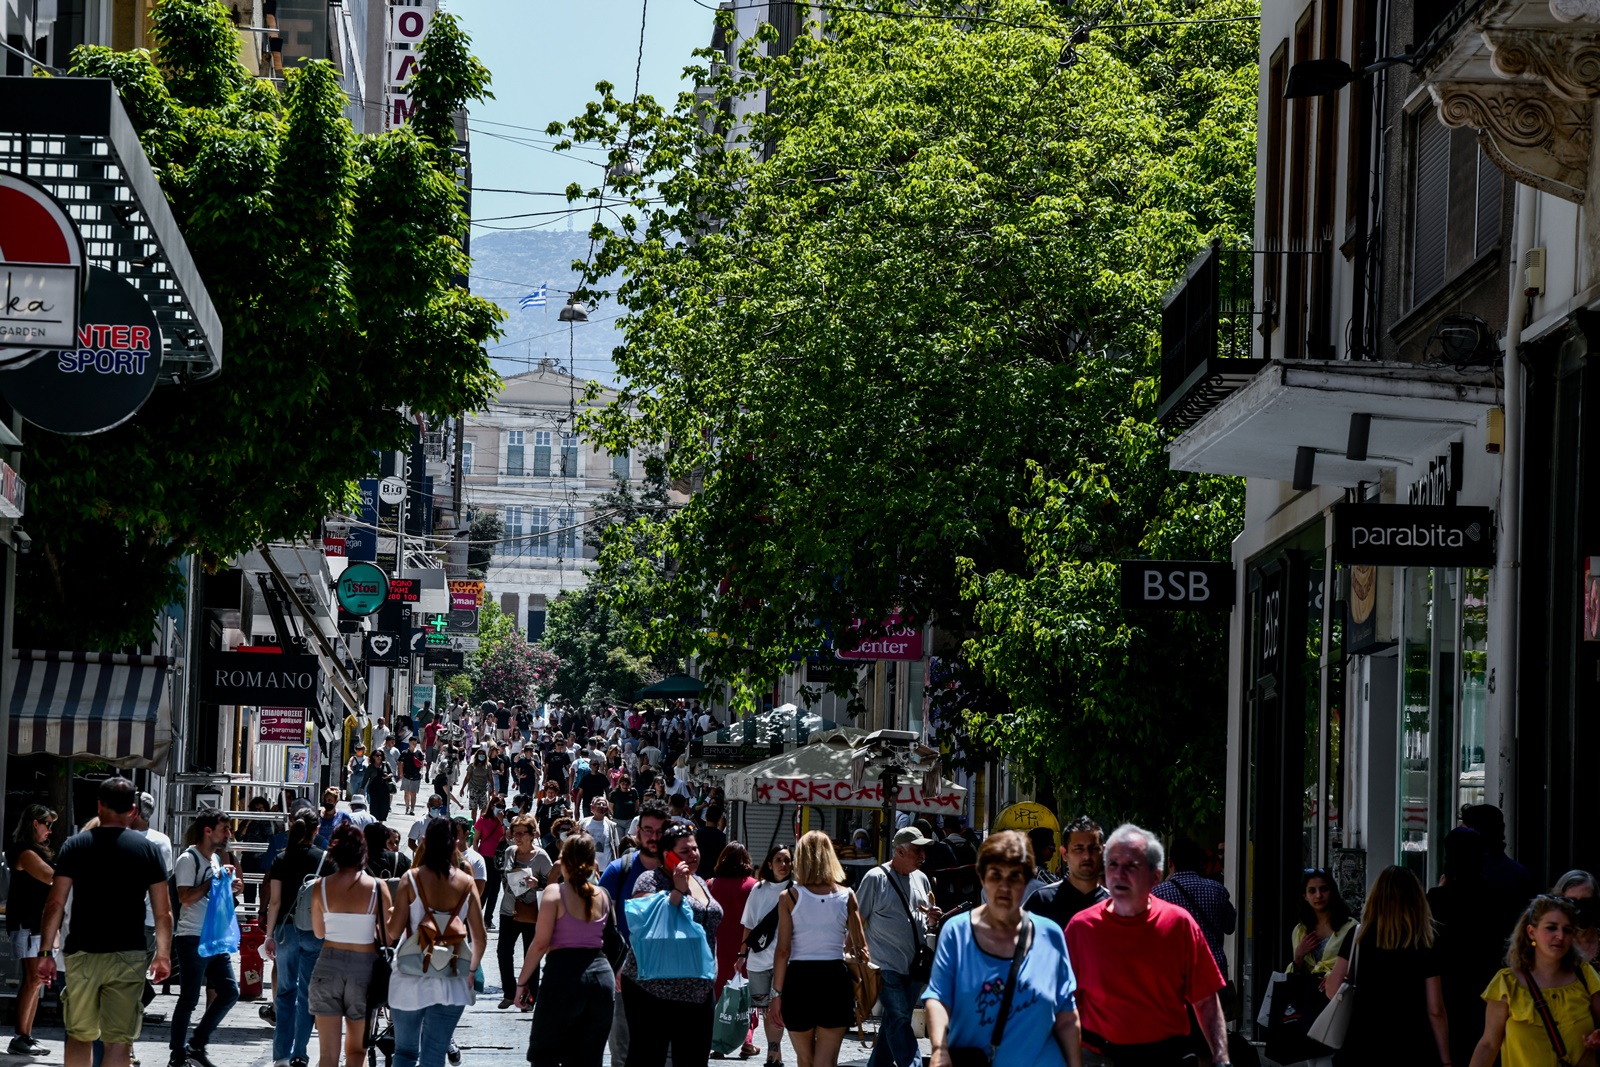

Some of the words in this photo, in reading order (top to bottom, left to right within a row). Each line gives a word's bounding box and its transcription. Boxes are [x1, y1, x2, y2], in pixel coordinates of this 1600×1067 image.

[0, 326, 46, 337] GARDEN
[58, 350, 151, 375] SPORT
[1351, 523, 1463, 549] parabita
[388, 579, 413, 587] ΦΩΝΟ
[1143, 571, 1210, 602] BSB
[403, 593, 418, 601] 100
[1263, 589, 1280, 660] BSB
[215, 670, 313, 690] ROMANO
[261, 709, 304, 717] ΕΠΙΔΙΟΡΘΩΣΕΙΣ
[703, 747, 738, 755] ERMOU
[739, 744, 770, 755] Flower
